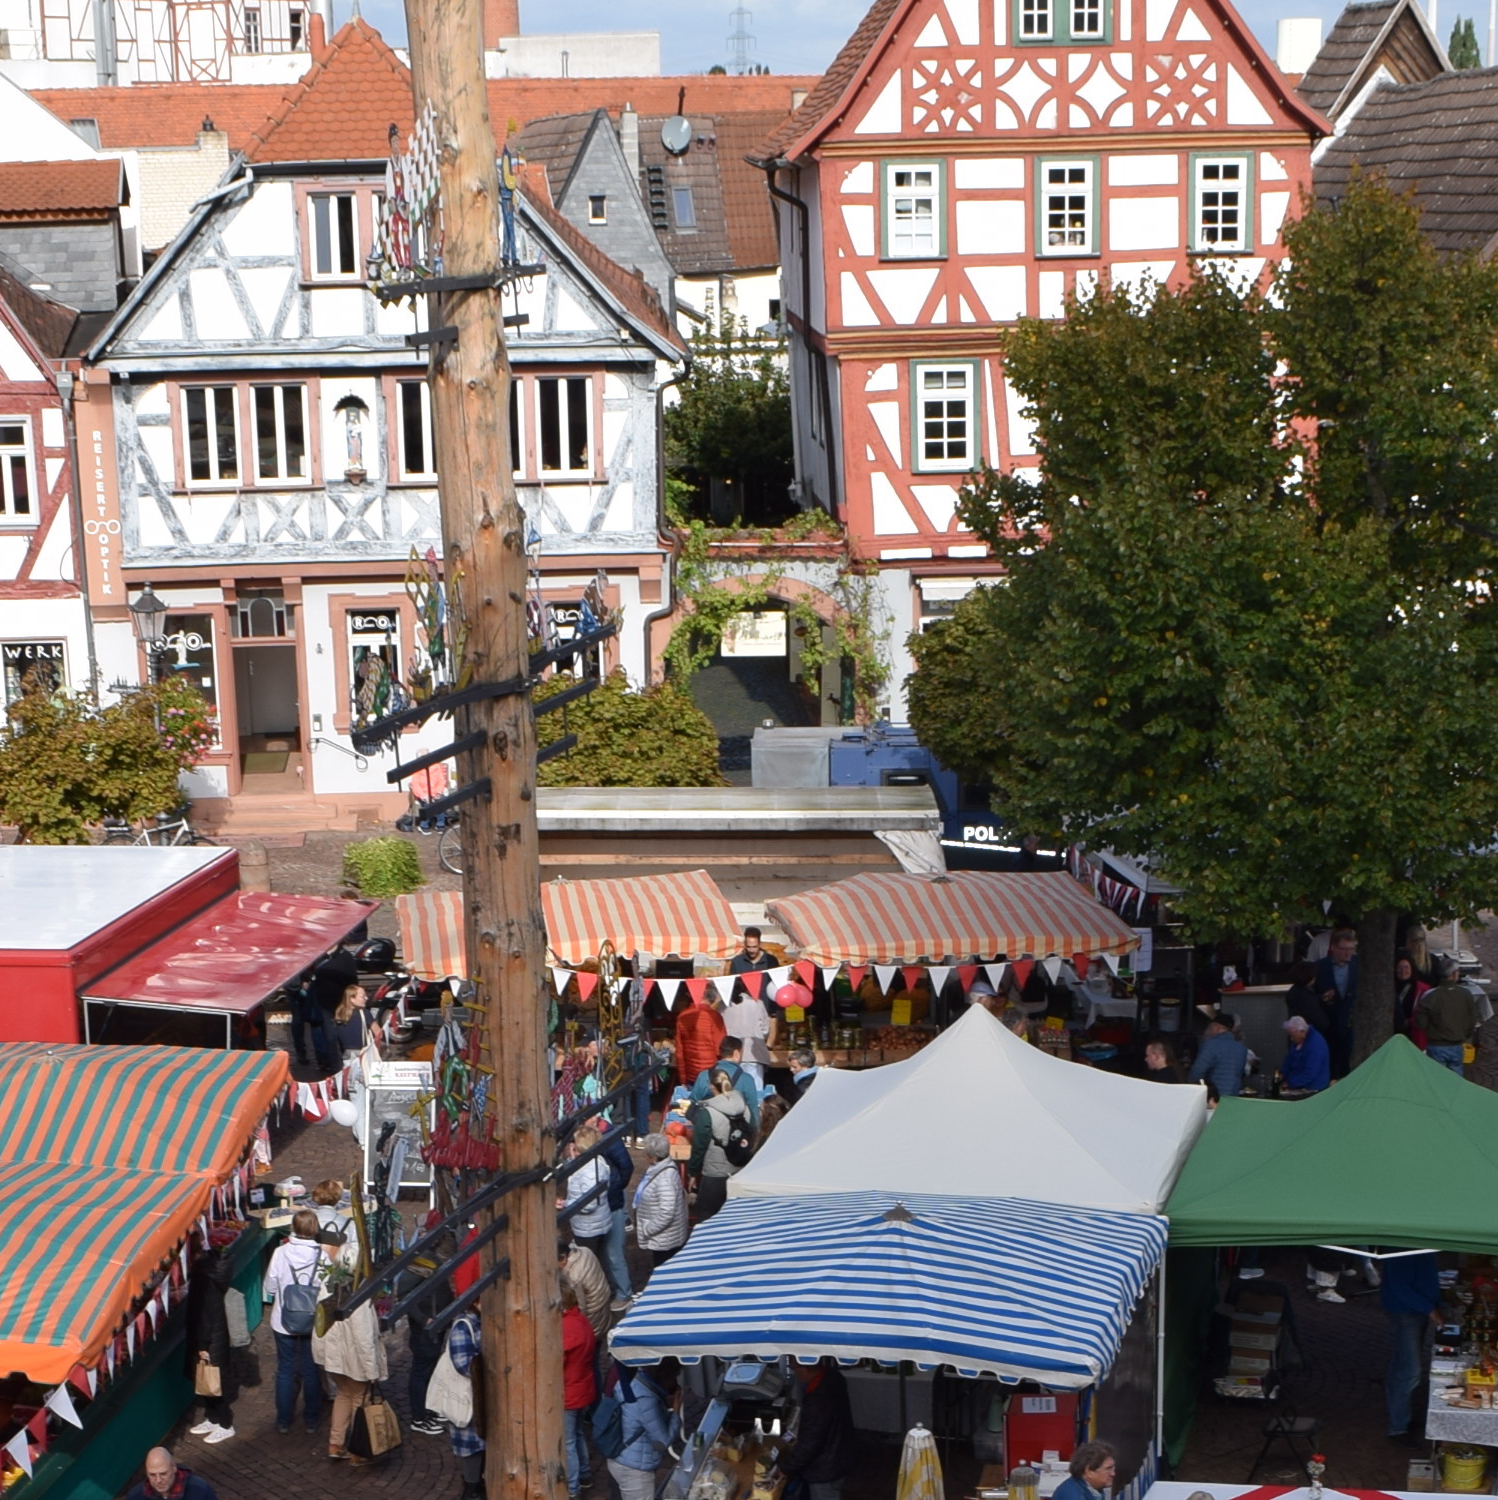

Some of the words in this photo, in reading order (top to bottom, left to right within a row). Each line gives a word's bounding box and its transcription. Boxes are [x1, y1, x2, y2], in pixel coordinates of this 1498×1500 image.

[92, 430, 106, 517] REISERT
[98, 533, 112, 595] OPTIK
[4, 645, 62, 660] WERK
